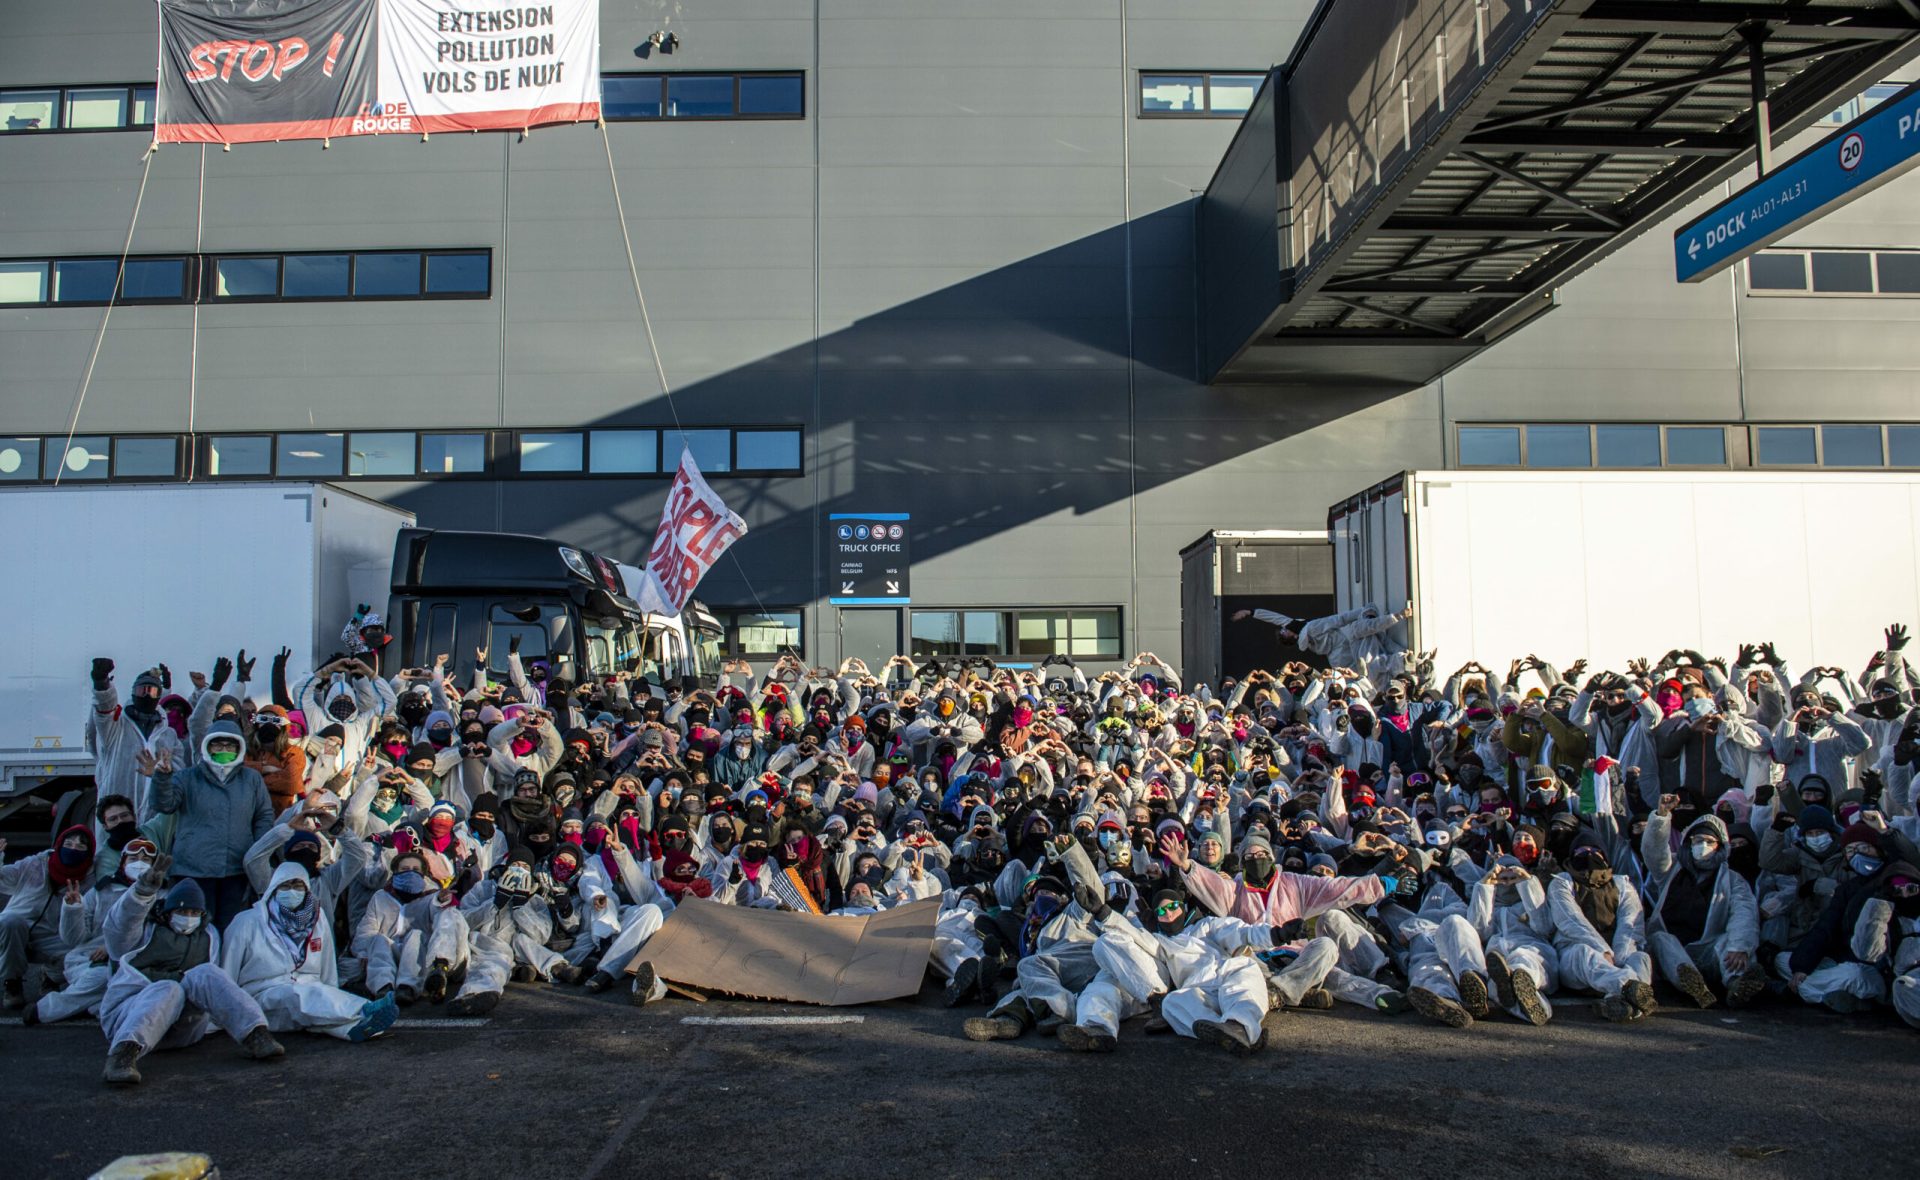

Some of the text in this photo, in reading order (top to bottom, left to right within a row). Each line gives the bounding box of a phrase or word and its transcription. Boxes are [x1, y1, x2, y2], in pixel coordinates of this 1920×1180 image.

[438, 6, 554, 33] EXTENSION
[186, 34, 311, 84] STOP
[437, 34, 554, 63] POLLUTION
[423, 62, 565, 94] VOLS DE NUIT
[352, 117, 412, 133] ROUGE
[1843, 142, 1860, 163] 20
[1706, 179, 1808, 250] DOCK AL01-AL31
[891, 528, 900, 536] 20
[839, 544, 901, 552] TRUCK OFFICE
